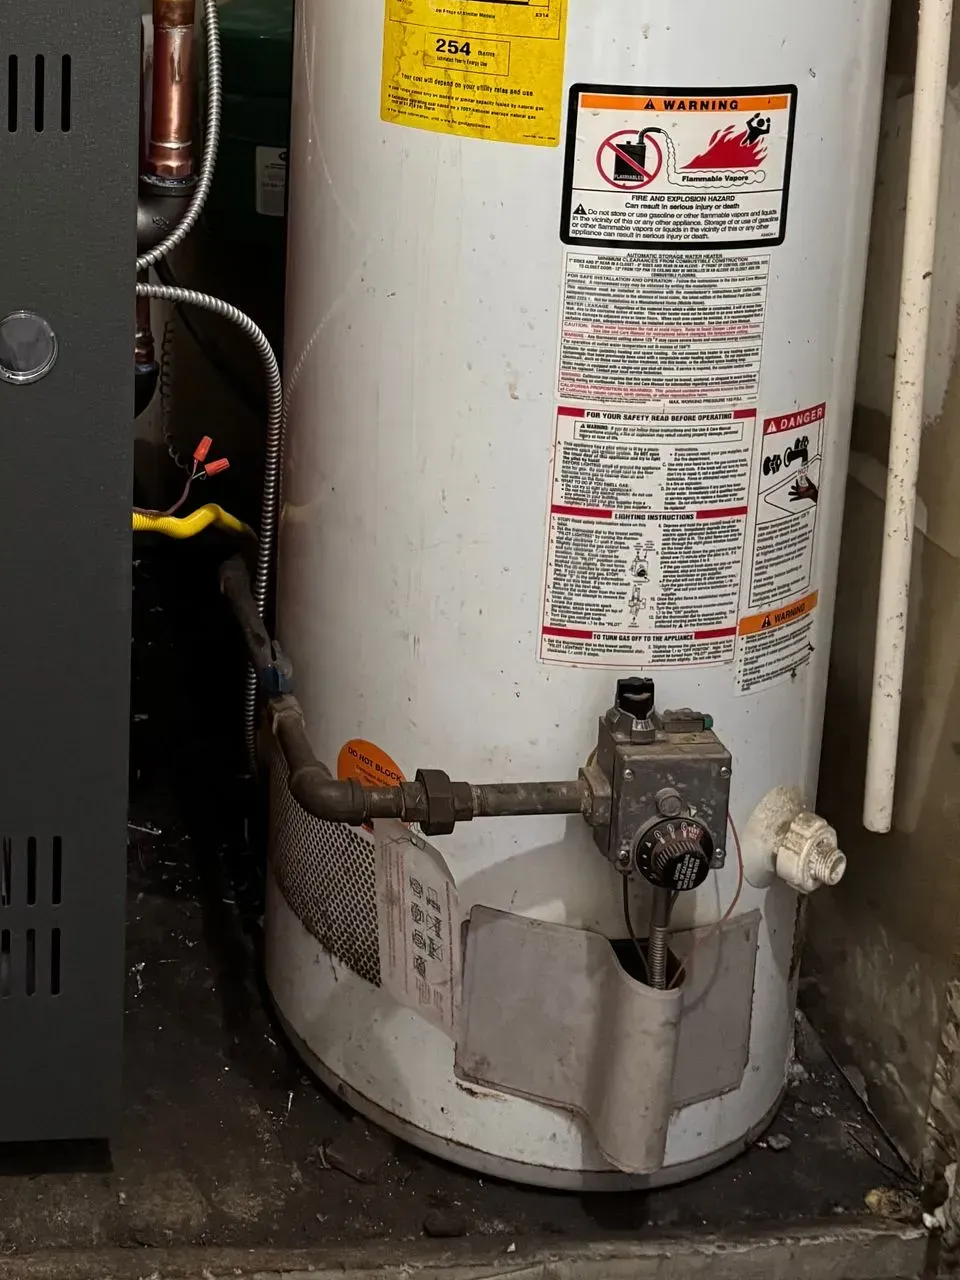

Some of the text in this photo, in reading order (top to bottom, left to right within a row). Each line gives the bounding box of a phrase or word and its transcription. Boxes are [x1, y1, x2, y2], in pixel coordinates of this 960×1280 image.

[435, 38, 471, 56] 254
[401, 73, 412, 81] Your
[434, 78, 453, 88] depend
[463, 83, 475, 91] your
[476, 84, 492, 93] utility
[663, 100, 739, 110] WARNING
[724, 174, 749, 183] Vapors
[698, 412, 732, 421] OPERATING
[780, 408, 822, 430] DANGER
[774, 603, 805, 623] WARNING
[348, 747, 357, 757] DO
[359, 754, 373, 767] NOT
[375, 764, 401, 781] BLOCK
